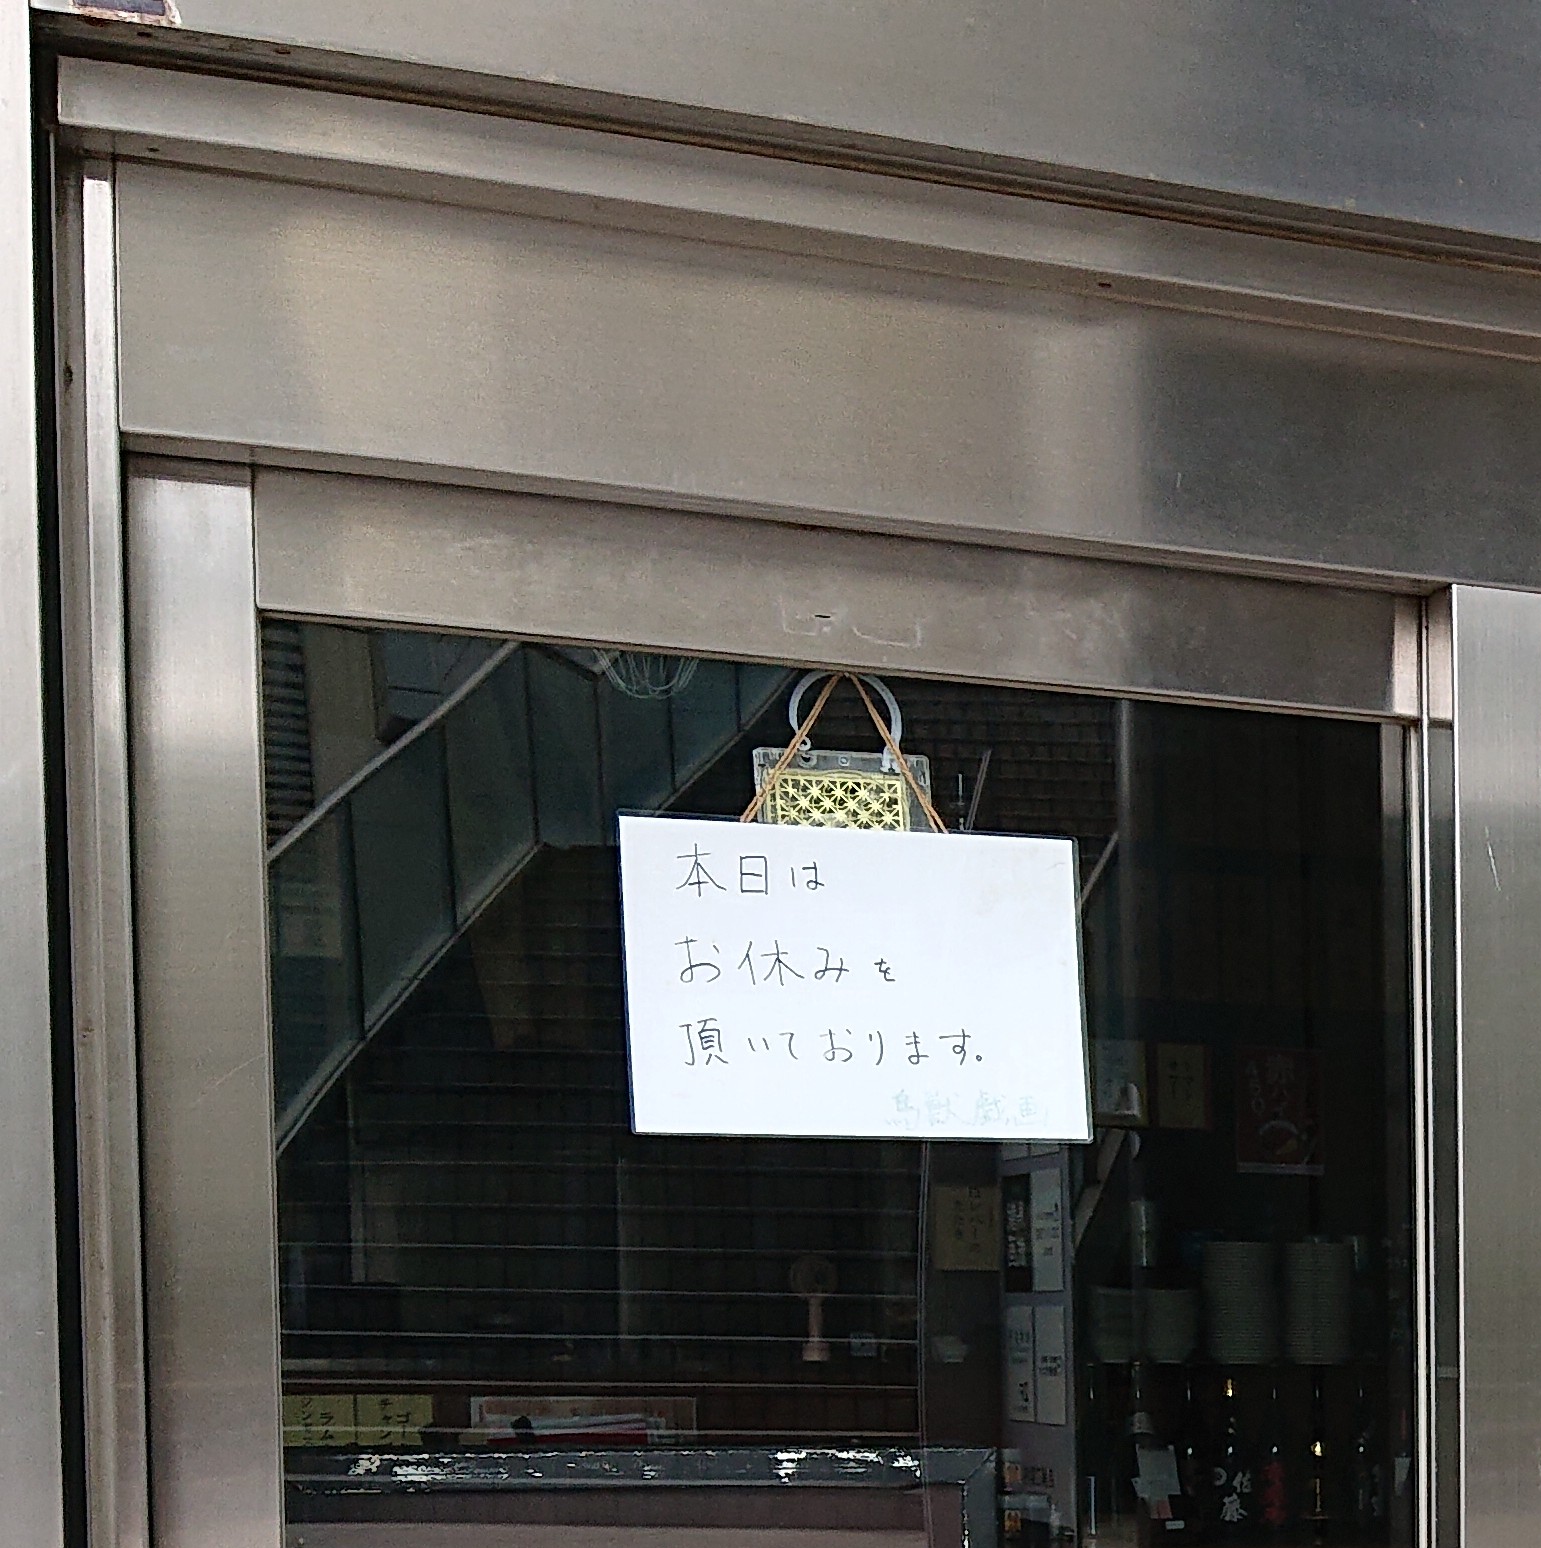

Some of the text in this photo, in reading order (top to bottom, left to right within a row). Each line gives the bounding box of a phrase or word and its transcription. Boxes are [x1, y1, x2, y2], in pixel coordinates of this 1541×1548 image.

[676, 843, 825, 897] 本日は
[674, 936, 896, 986] お休みを
[678, 1018, 984, 1066] 頂いております。
